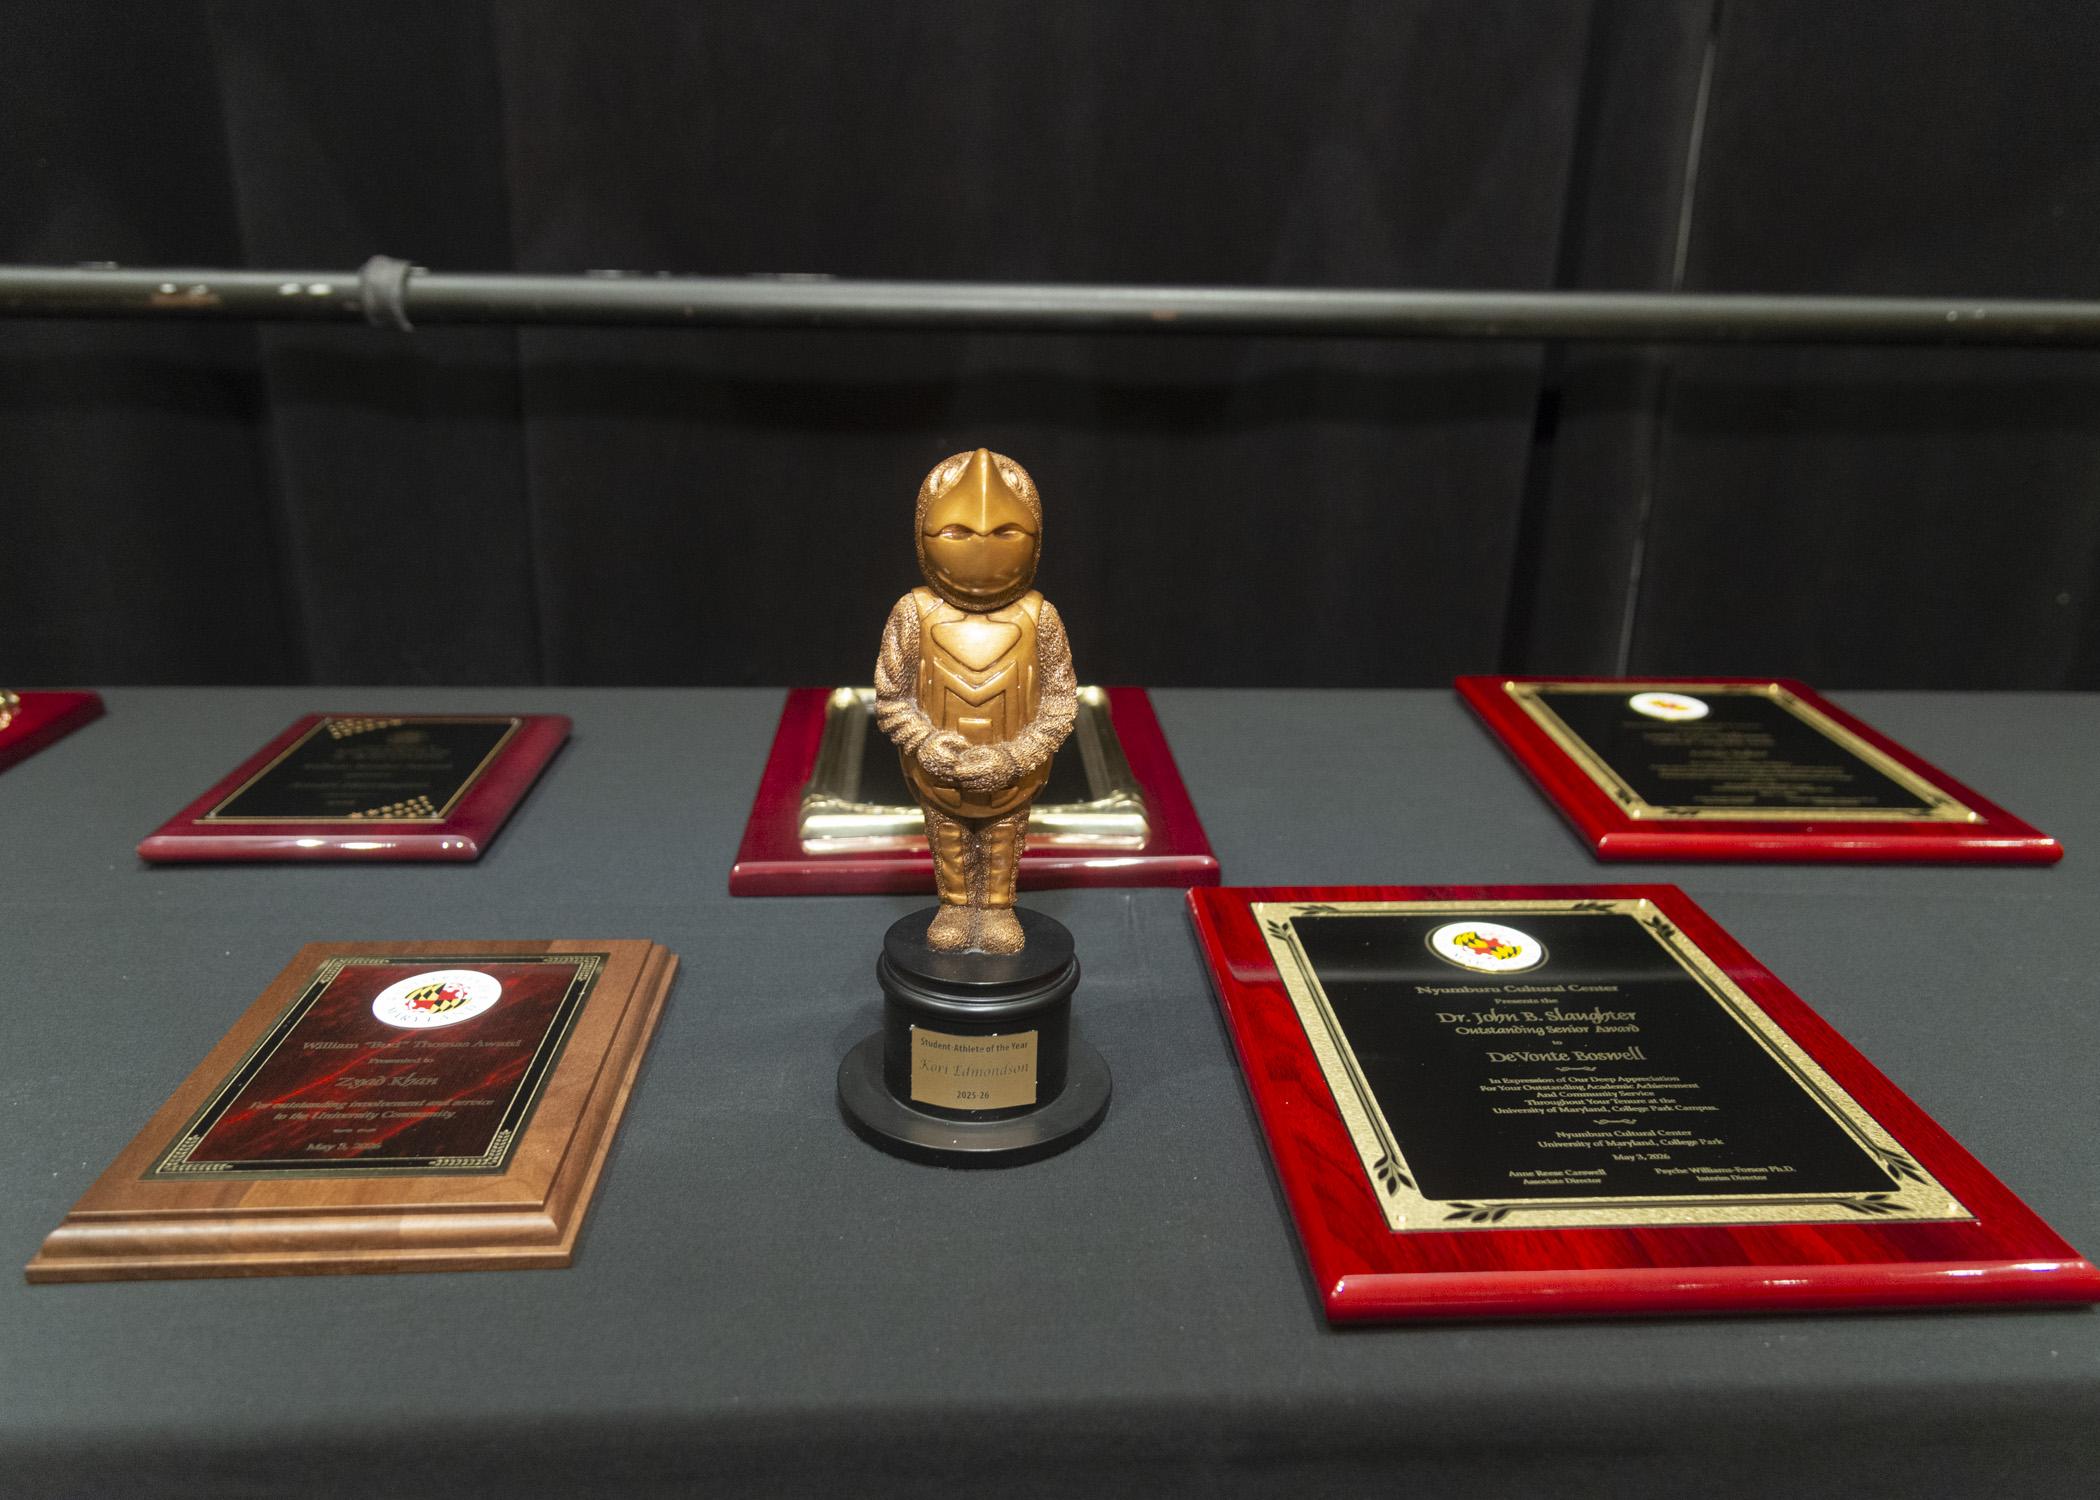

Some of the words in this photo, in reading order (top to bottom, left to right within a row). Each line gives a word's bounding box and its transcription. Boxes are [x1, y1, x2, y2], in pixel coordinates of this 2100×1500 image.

[1414, 985, 1501, 996] Nyumburu
[1503, 984, 1566, 993] Cultural
[1567, 984, 1619, 992] Center
[1435, 1012, 1471, 1023] Dr.
[1472, 1007, 1520, 1025] John
[1520, 1011, 1544, 1021] B.
[1544, 1006, 1637, 1024] Slaughter
[1455, 1025, 1545, 1036] Outstanding
[1545, 1024, 1590, 1034] Senior
[1595, 1024, 1640, 1033] Award
[303, 1041, 359, 1050] William
[413, 1040, 470, 1048] Thomas
[471, 1039, 522, 1048] Award
[985, 1045, 995, 1053] of
[1011, 1041, 1028, 1050] Year
[1485, 1051, 1571, 1062] DeVonte
[1571, 1046, 1648, 1061] Boswell
[920, 1057, 949, 1074] Kori
[953, 1063, 1029, 1078] Edmondson
[388, 1072, 439, 1087] Khan
[1502, 1077, 1555, 1085] Expression
[1618, 1075, 1680, 1083] Appreciation
[1636, 1082, 1700, 1090] Achievement
[288, 1111, 309, 1120] the
[311, 1110, 380, 1121] University
[1492, 1107, 1544, 1115] University
[1558, 1106, 1611, 1114] Maryland,
[1611, 1105, 1649, 1113] College
[1555, 1131, 1613, 1139] Nyumburu
[1613, 1130, 1656, 1138] Cultural
[305, 1142, 336, 1153] May
[1537, 1140, 1591, 1149] University
[1603, 1139, 1659, 1148] Maryland,
[1660, 1139, 1698, 1147] College
[1612, 1153, 1635, 1162] May
